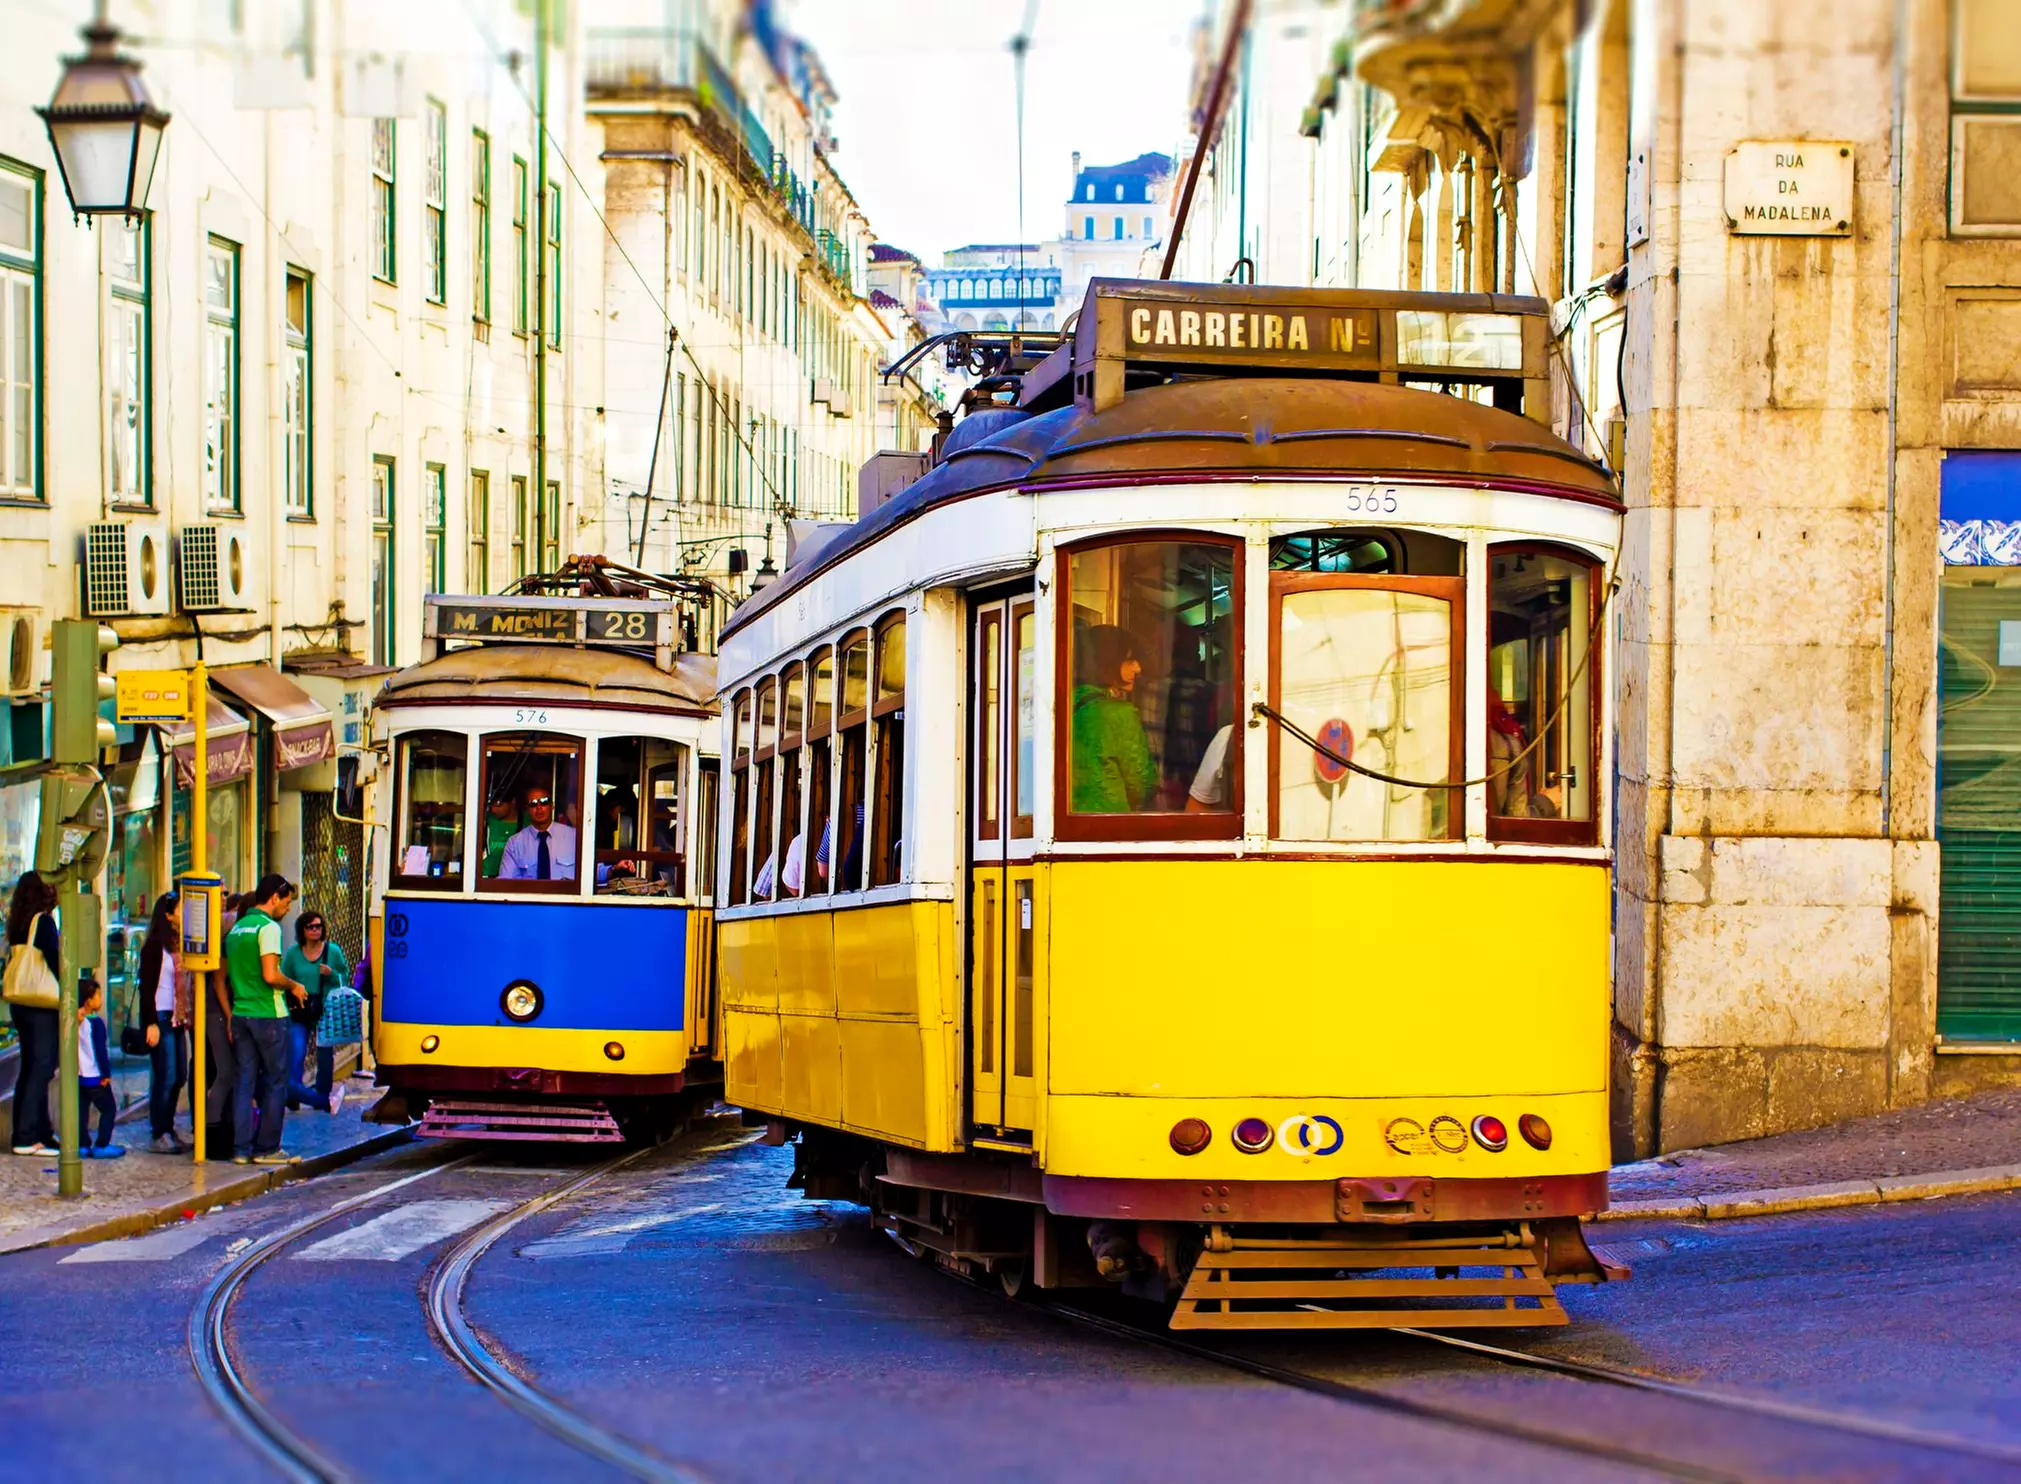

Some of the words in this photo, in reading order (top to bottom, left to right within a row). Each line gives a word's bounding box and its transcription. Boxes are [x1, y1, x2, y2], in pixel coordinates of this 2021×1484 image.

[1775, 154, 1804, 168] RUA
[1778, 180, 1799, 194] DA
[1744, 205, 1832, 221] MADALENA
[1131, 308, 1309, 350] CARREIRA
[1347, 487, 1397, 513] 565
[453, 611, 479, 631] M.
[604, 612, 646, 639] 28
[516, 709, 547, 724] 576
